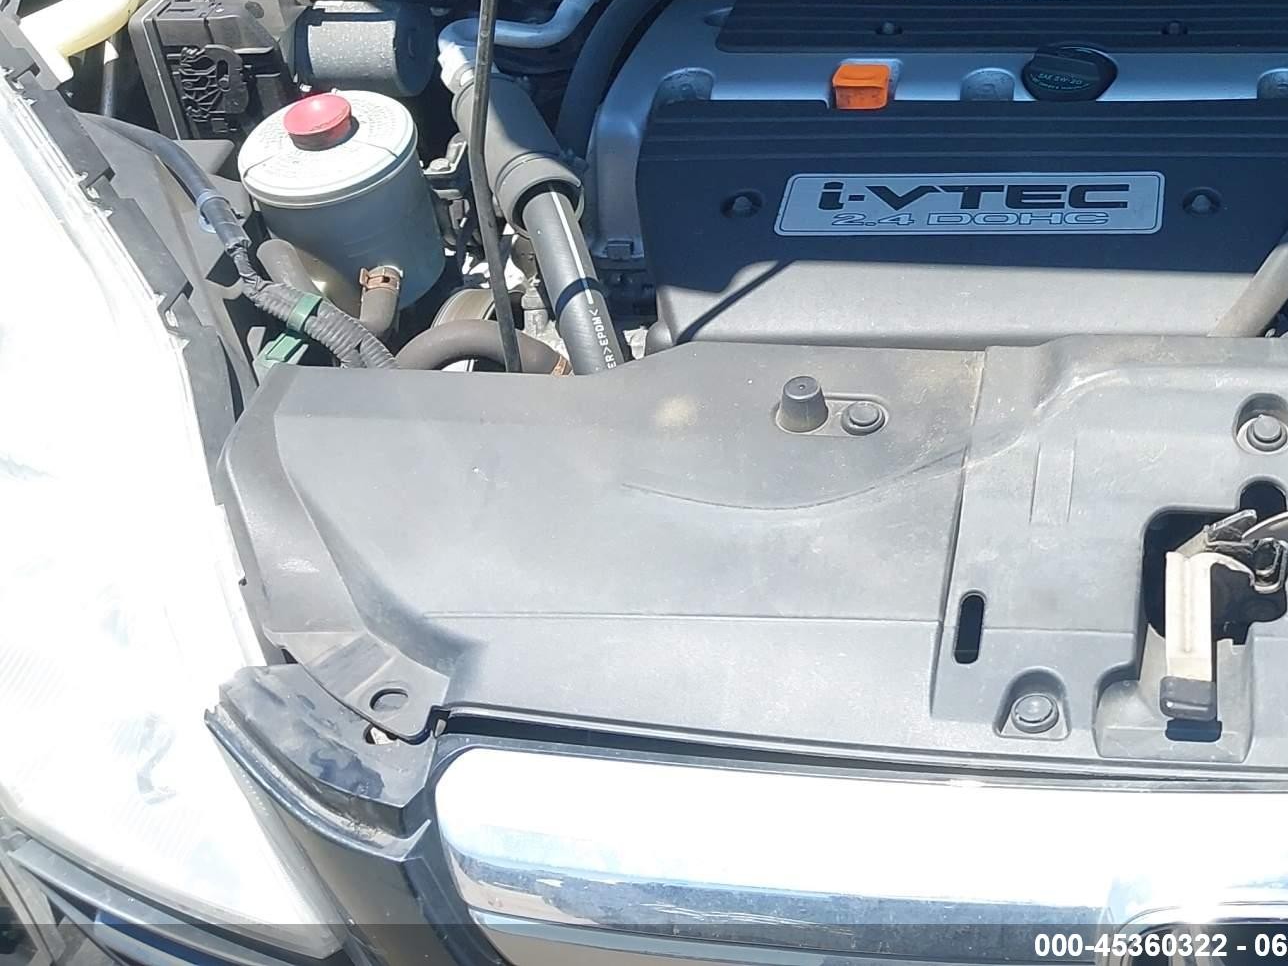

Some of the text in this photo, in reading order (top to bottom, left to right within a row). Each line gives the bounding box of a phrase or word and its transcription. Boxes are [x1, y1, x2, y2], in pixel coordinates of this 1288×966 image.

[818, 181, 1130, 210] i-VTEC
[832, 211, 1110, 227] 2.4 DOHC
